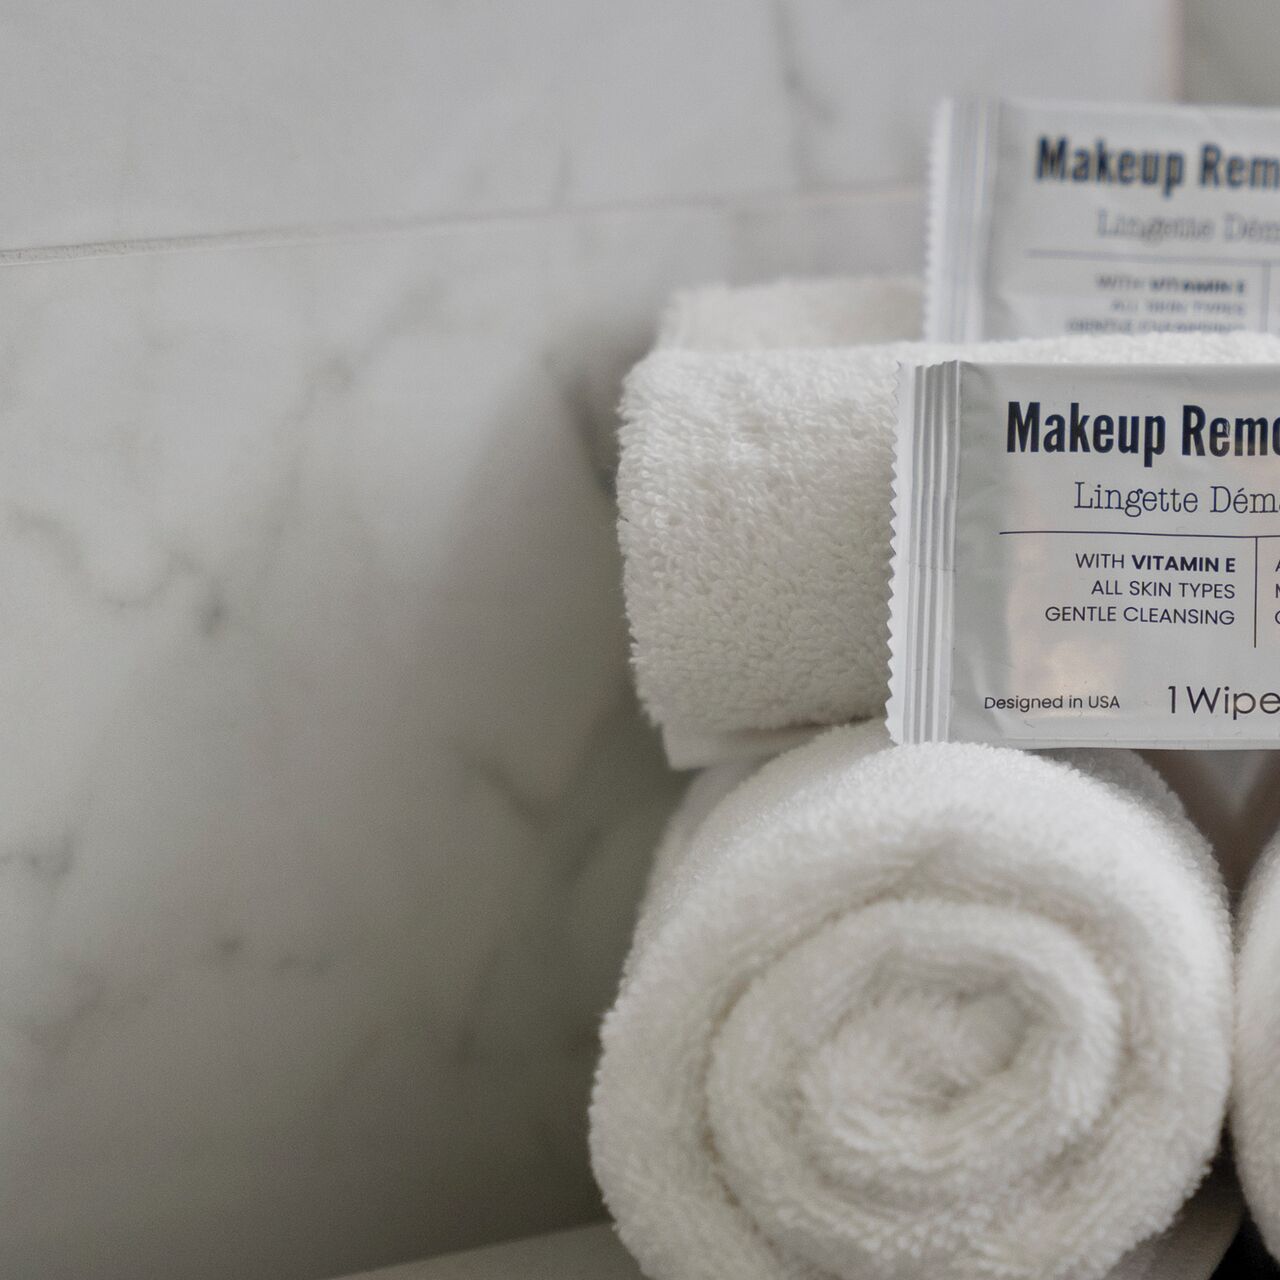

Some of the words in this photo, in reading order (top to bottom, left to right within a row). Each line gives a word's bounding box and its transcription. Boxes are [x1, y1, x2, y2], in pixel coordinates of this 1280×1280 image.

[1036, 136, 1184, 201] Makeup
[1007, 401, 1166, 468] Makeup
[1074, 481, 1198, 518] Lingette
[1075, 553, 1125, 569] WITH
[1131, 554, 1219, 573] VITAMIN
[1226, 558, 1236, 573] E
[1091, 580, 1123, 595] ALL
[1129, 580, 1172, 597] SKIN
[1178, 582, 1236, 599] TYPES
[1045, 606, 1117, 622] GENTLE
[1123, 606, 1235, 626] CLEANSING
[984, 695, 1063, 713] Designed
[1069, 695, 1083, 709] in
[1088, 695, 1121, 709] USA
